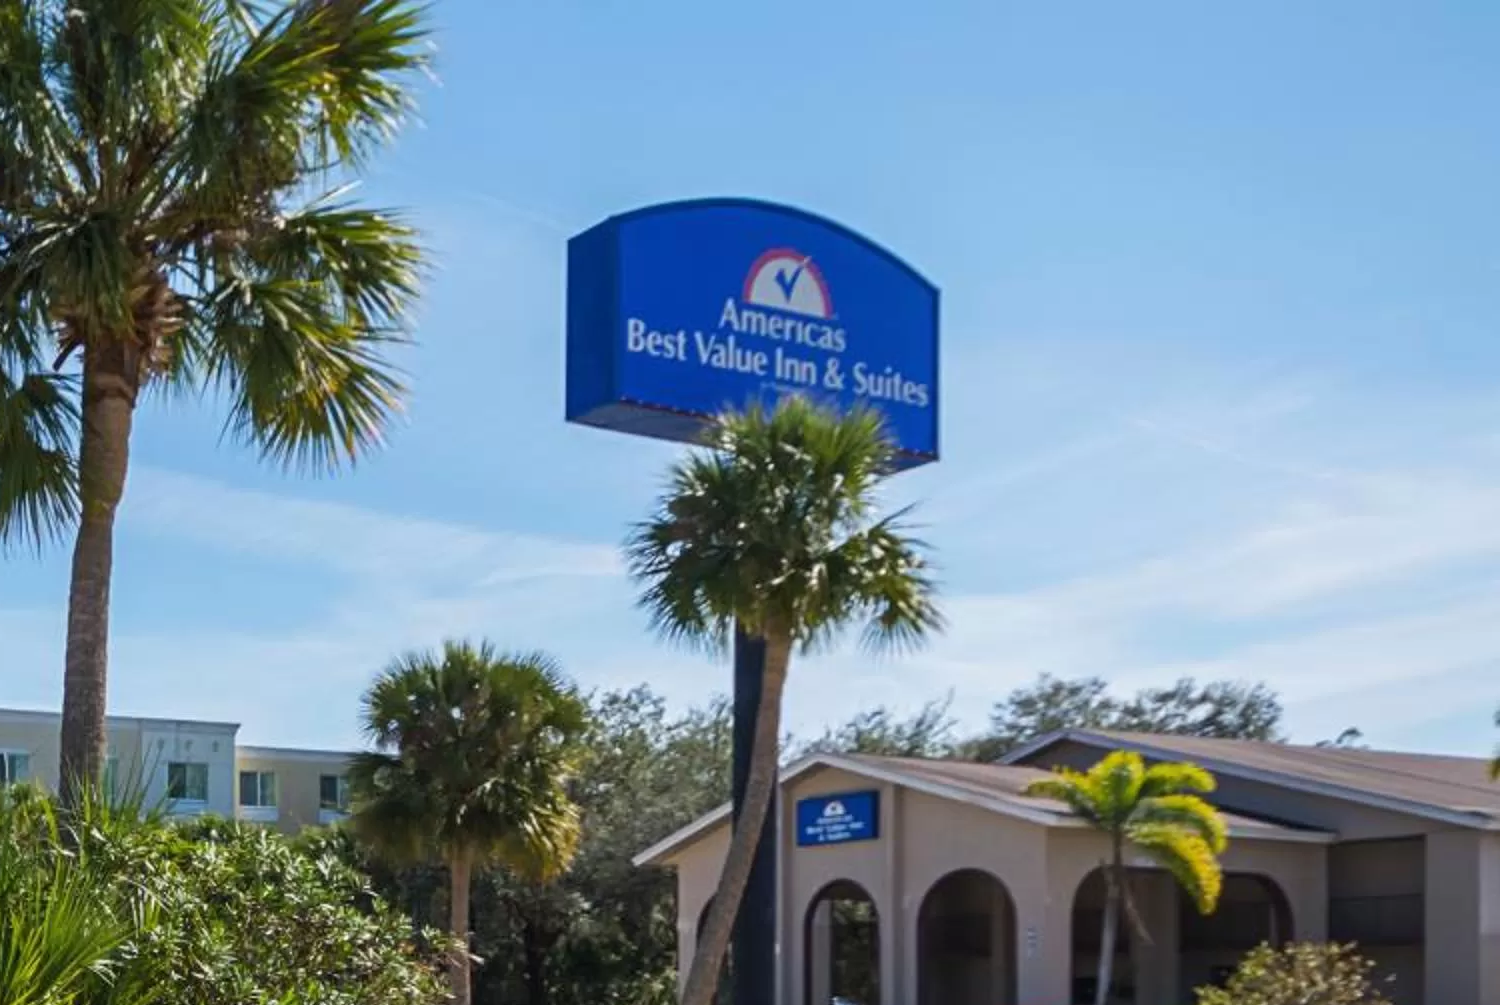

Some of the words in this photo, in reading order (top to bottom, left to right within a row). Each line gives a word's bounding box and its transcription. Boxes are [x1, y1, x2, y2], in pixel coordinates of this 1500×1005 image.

[719, 298, 846, 353] Americas
[626, 318, 687, 361] Best
[694, 332, 769, 376] Value
[775, 348, 817, 385] Inn
[823, 358, 844, 389] &
[854, 362, 929, 407] Suites
